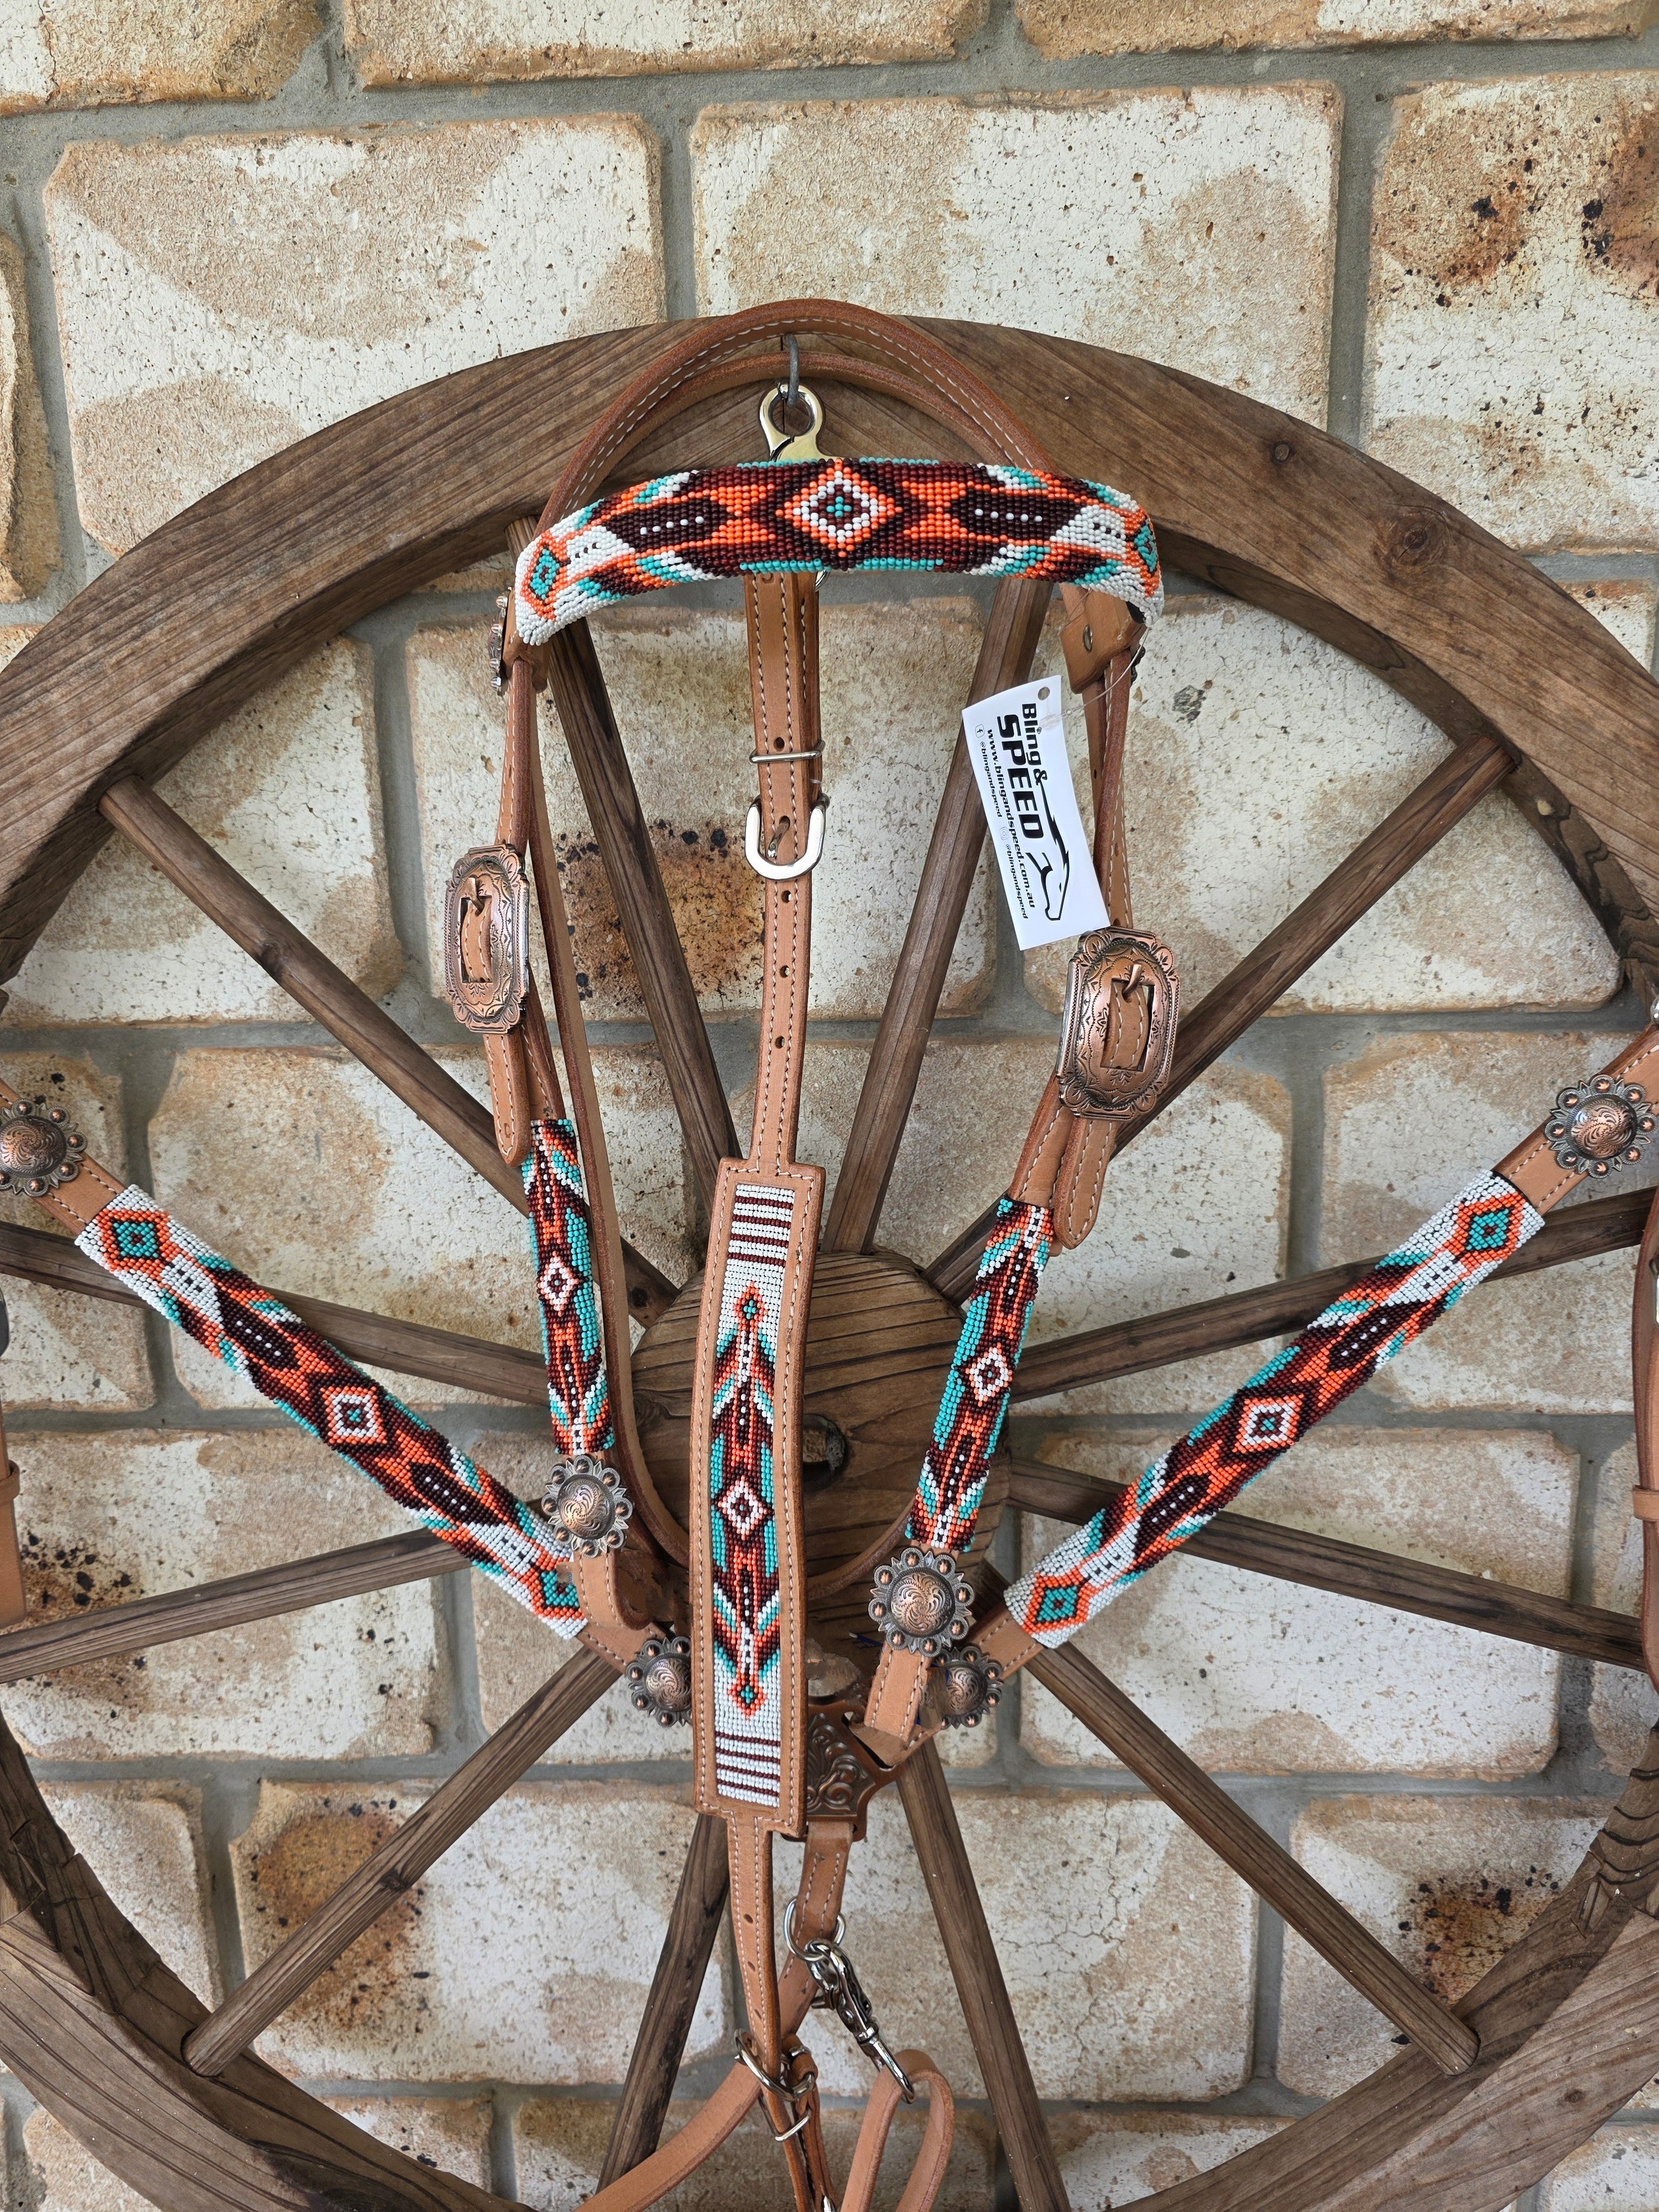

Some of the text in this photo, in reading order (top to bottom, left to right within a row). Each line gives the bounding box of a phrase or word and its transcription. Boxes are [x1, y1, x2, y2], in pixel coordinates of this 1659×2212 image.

[987, 729, 1035, 908] www.blingandspeed.com.au
[997, 714, 1044, 839] SPEED
[1022, 703, 1047, 786] Bling &
[980, 742, 1028, 919] @blingandspeed @blingandspeed
